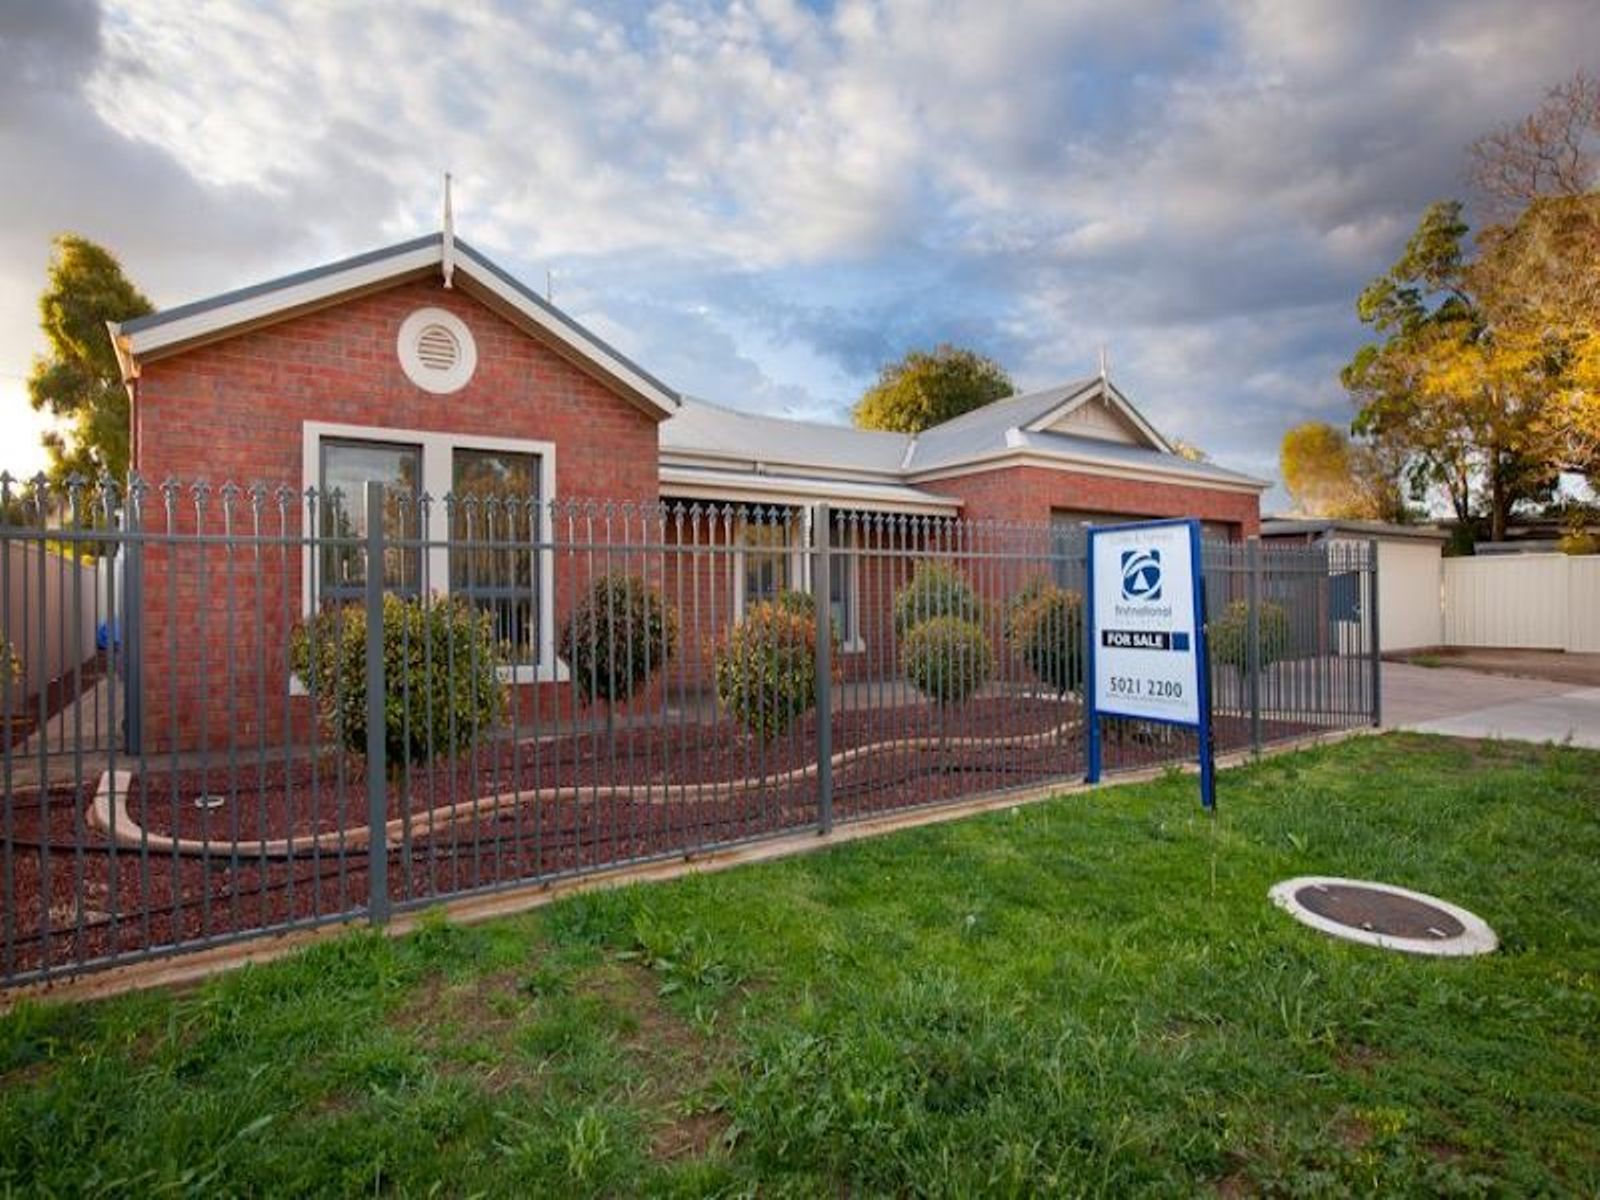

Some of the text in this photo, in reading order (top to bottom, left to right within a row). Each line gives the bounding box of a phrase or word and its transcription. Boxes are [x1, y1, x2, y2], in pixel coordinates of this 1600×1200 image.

[1107, 632, 1163, 648] FOR SALE
[1110, 677, 1183, 698] 5021 2200
